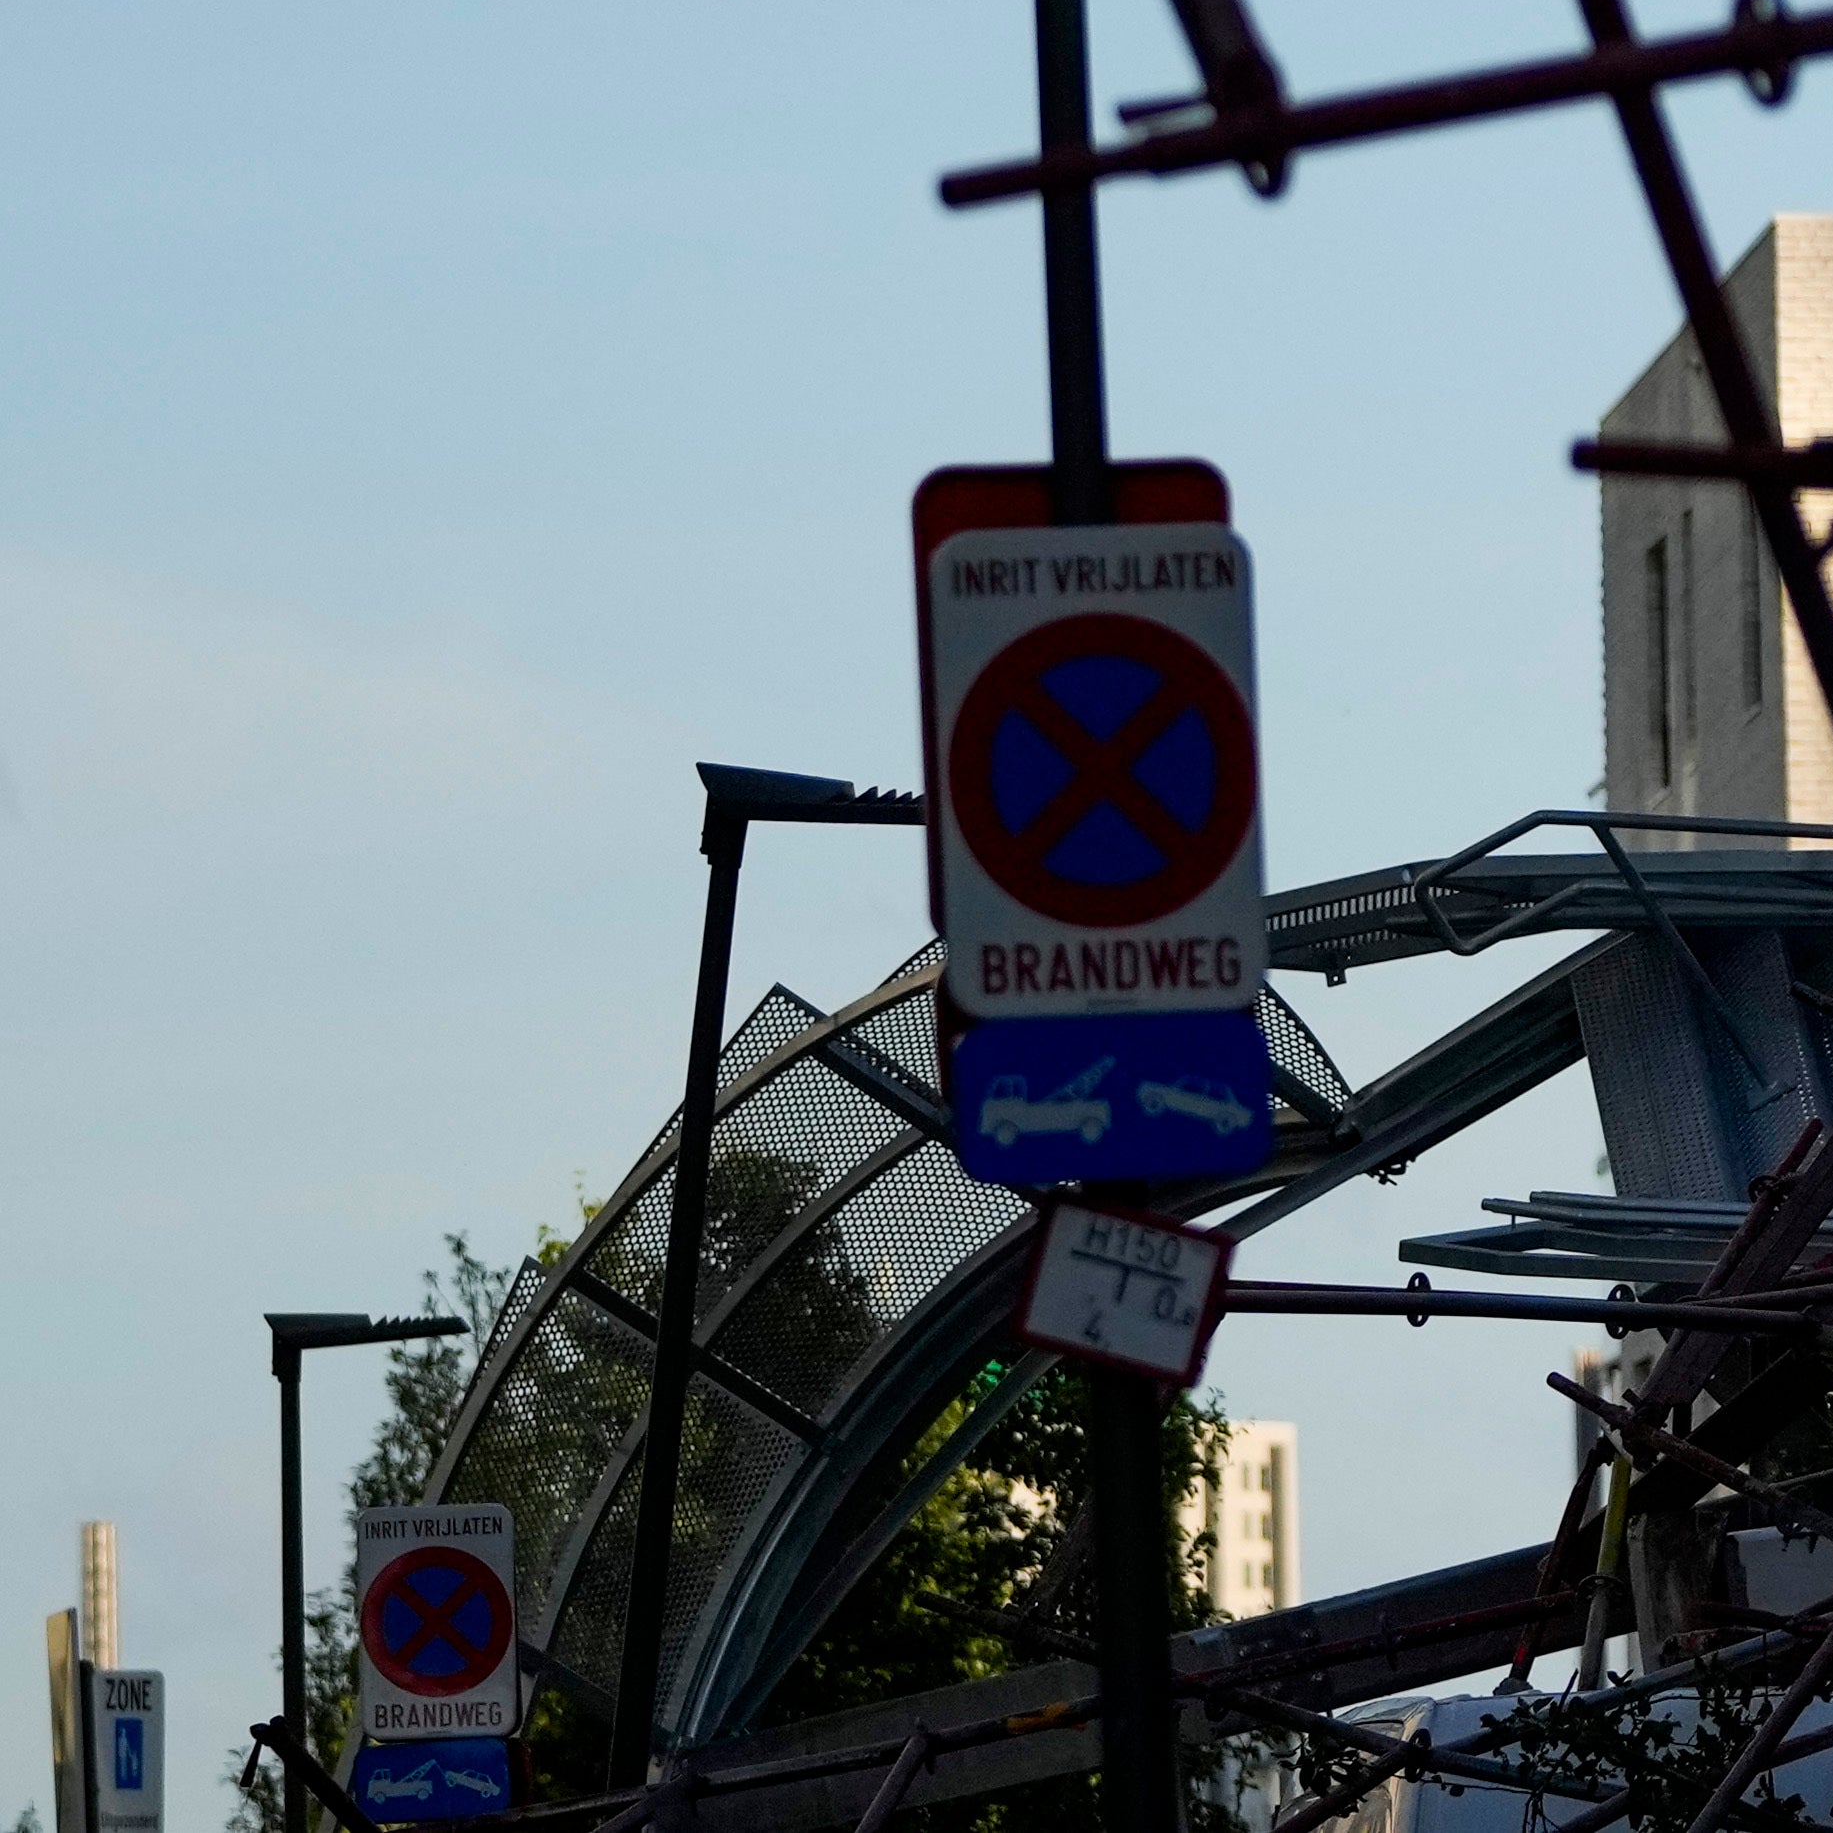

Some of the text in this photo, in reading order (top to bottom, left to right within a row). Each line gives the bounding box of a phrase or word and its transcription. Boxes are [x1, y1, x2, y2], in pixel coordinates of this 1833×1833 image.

[951, 552, 1236, 598] INRIT VRIJLATEN
[981, 936, 1242, 995] BRANDWEG
[1085, 1219, 1182, 1270] H150
[364, 1516, 503, 1539] INRIT VRIJLATEN
[105, 1678, 152, 1712] ZONE
[375, 1701, 502, 1729] BRANDWEG
